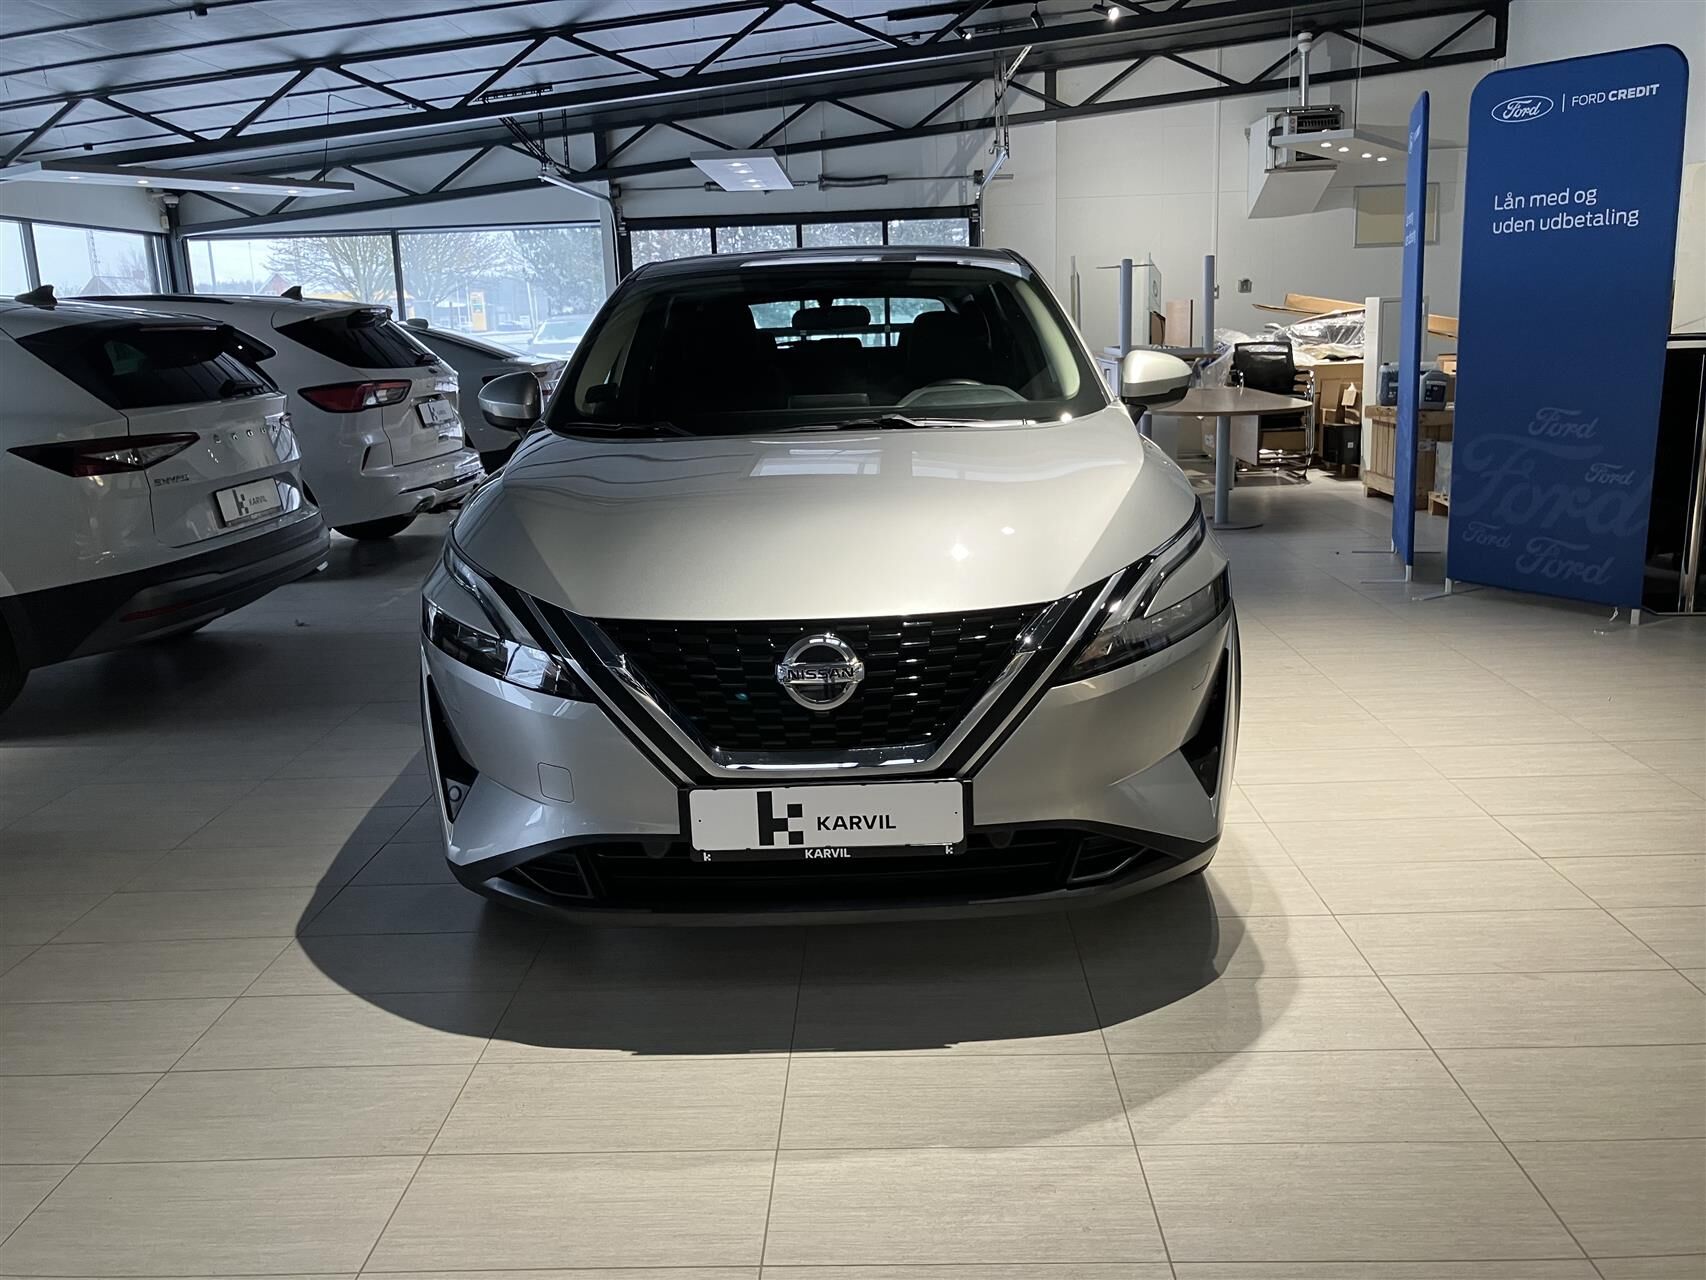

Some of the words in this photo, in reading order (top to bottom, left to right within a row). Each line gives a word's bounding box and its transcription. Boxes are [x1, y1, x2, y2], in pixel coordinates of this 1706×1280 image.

[1571, 92, 1606, 107] FORD
[1608, 84, 1660, 101] CREDIT
[1502, 99, 1542, 119] Ford
[1494, 191, 1525, 211] Lån
[1529, 187, 1570, 207] med
[1574, 188, 1597, 206] og
[1493, 217, 1535, 234] uden
[1539, 208, 1639, 230] udbetaling
[1528, 407, 1599, 438] Ford
[1451, 433, 1651, 537] Ford
[1585, 462, 1636, 486] Ford
[1462, 521, 1512, 548] Ford
[1515, 536, 1616, 585] Ford
[787, 667, 854, 681] NISSAN
[817, 814, 896, 831] KARVIL
[804, 848, 851, 859] KARVIL
